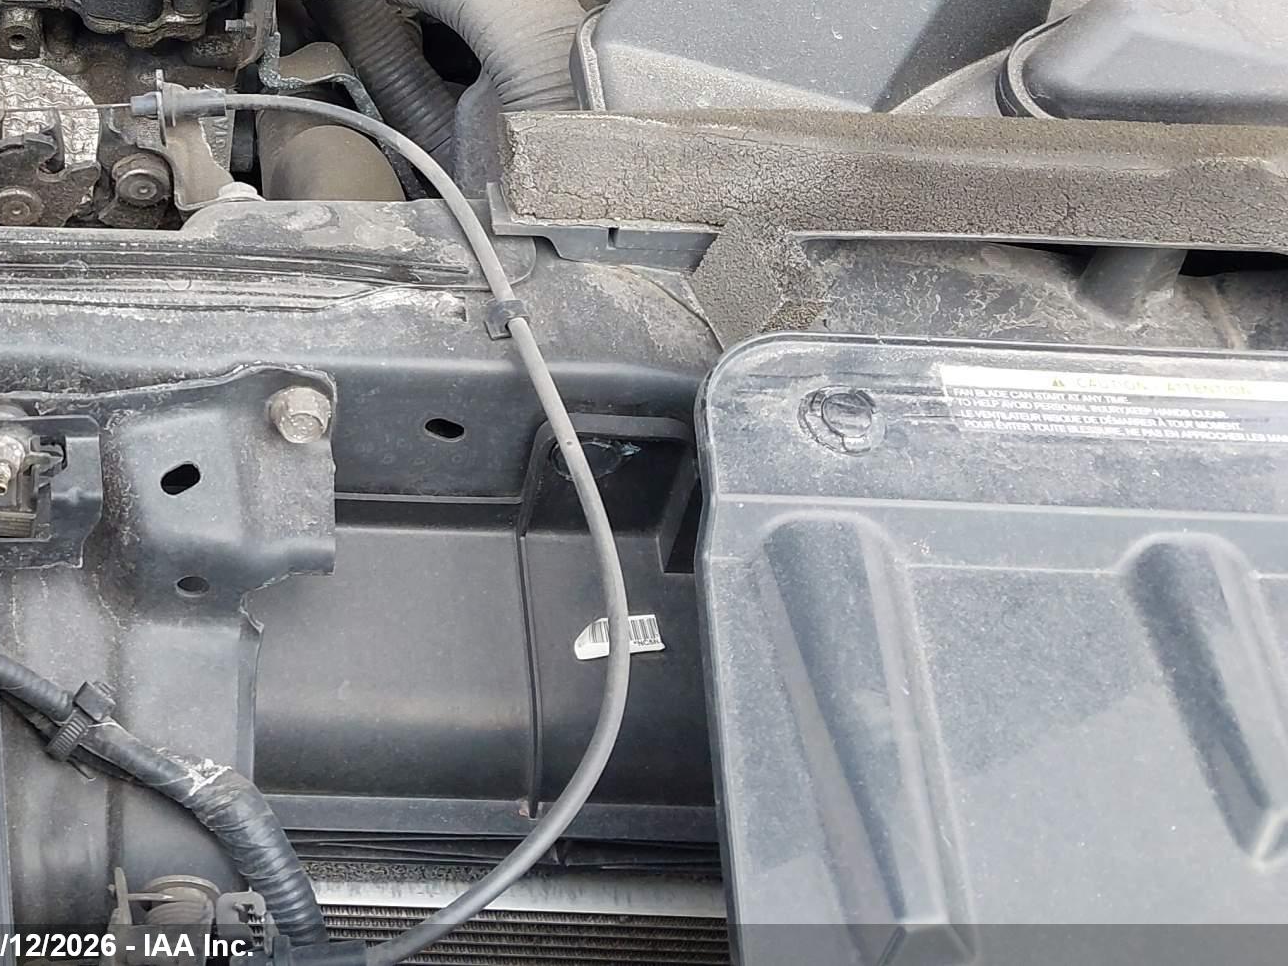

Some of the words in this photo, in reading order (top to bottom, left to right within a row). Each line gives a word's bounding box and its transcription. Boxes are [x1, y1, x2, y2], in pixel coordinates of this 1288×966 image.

[953, 387, 973, 396] FAN
[1010, 390, 1033, 399] CAN
[1034, 392, 1065, 401] START
[1067, 393, 1081, 402] AT
[1082, 394, 1101, 403] ANY
[958, 398, 972, 406] TO
[973, 398, 1001, 408] HELP
[1001, 400, 1032, 409] AVOID
